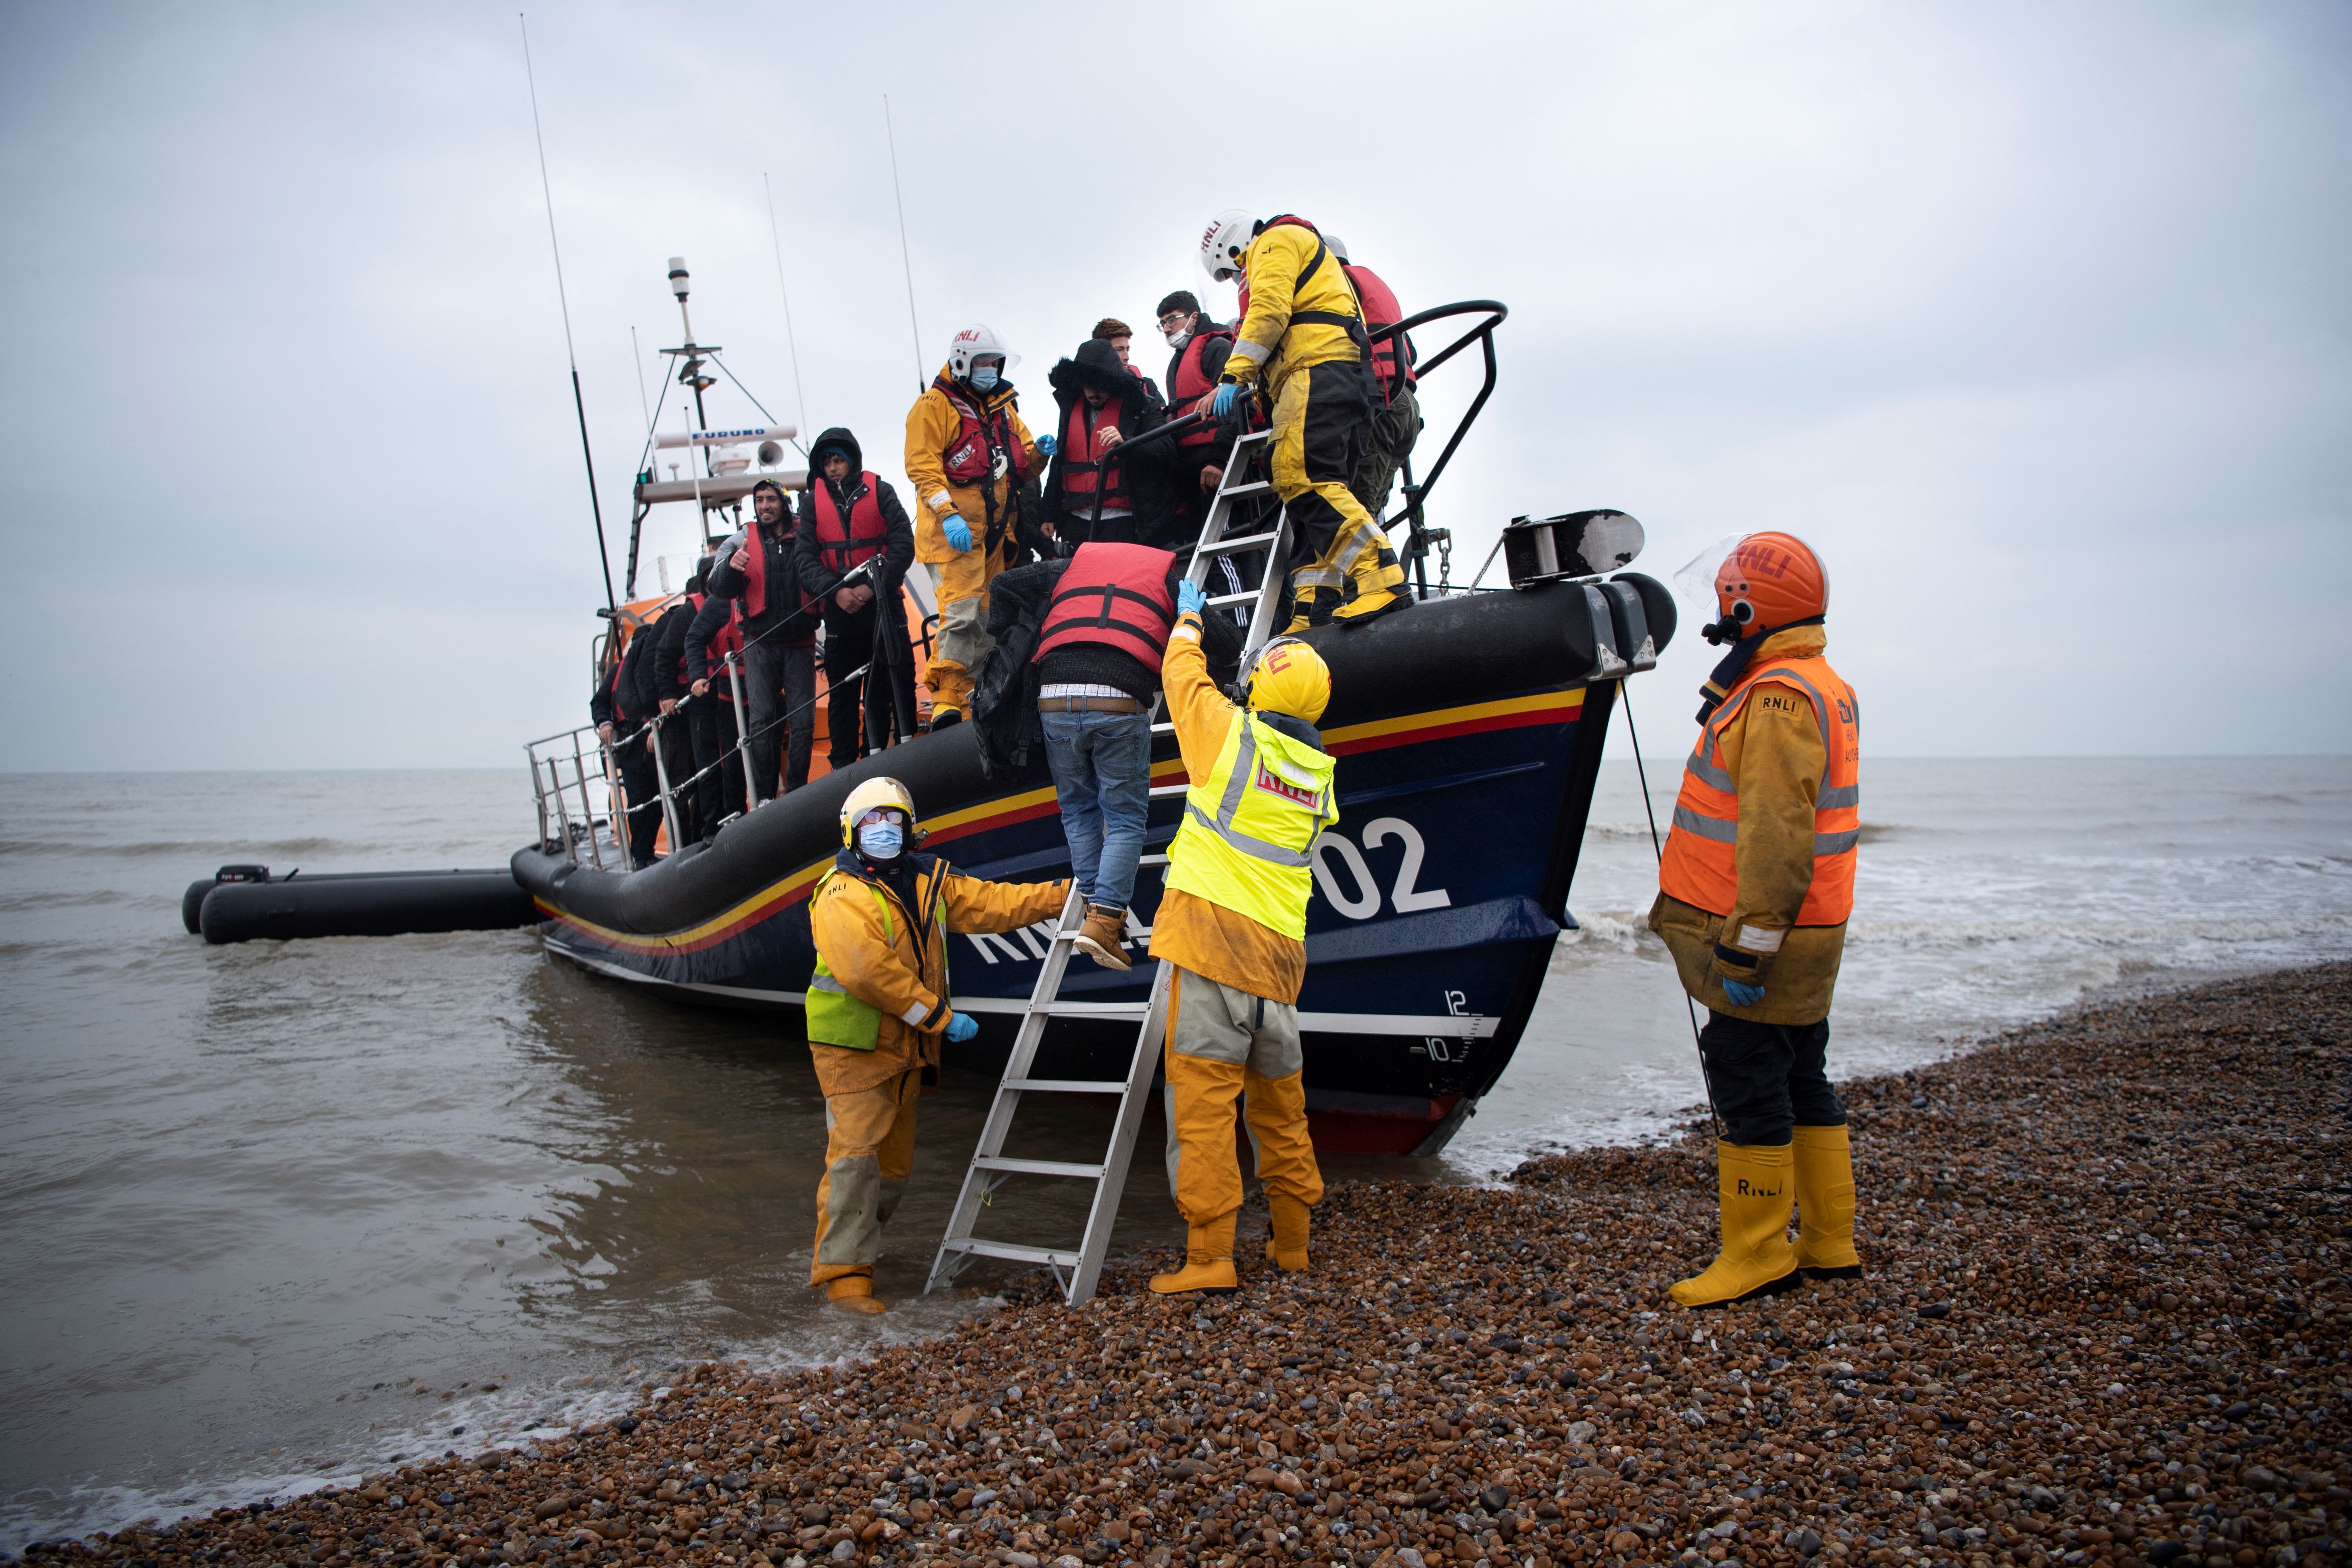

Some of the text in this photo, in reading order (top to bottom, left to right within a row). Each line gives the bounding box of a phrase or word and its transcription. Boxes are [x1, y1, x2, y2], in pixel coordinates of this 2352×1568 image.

[692, 429, 765, 440] FURUNO
[951, 447, 970, 468] RNLI
[1727, 544, 1792, 579] RNLI
[1266, 645, 1292, 675] NLI
[1763, 697, 1796, 712] RNLI
[828, 883, 846, 897] RNLI
[1445, 990, 1470, 1016] 12
[1425, 1037, 1449, 1061] 10
